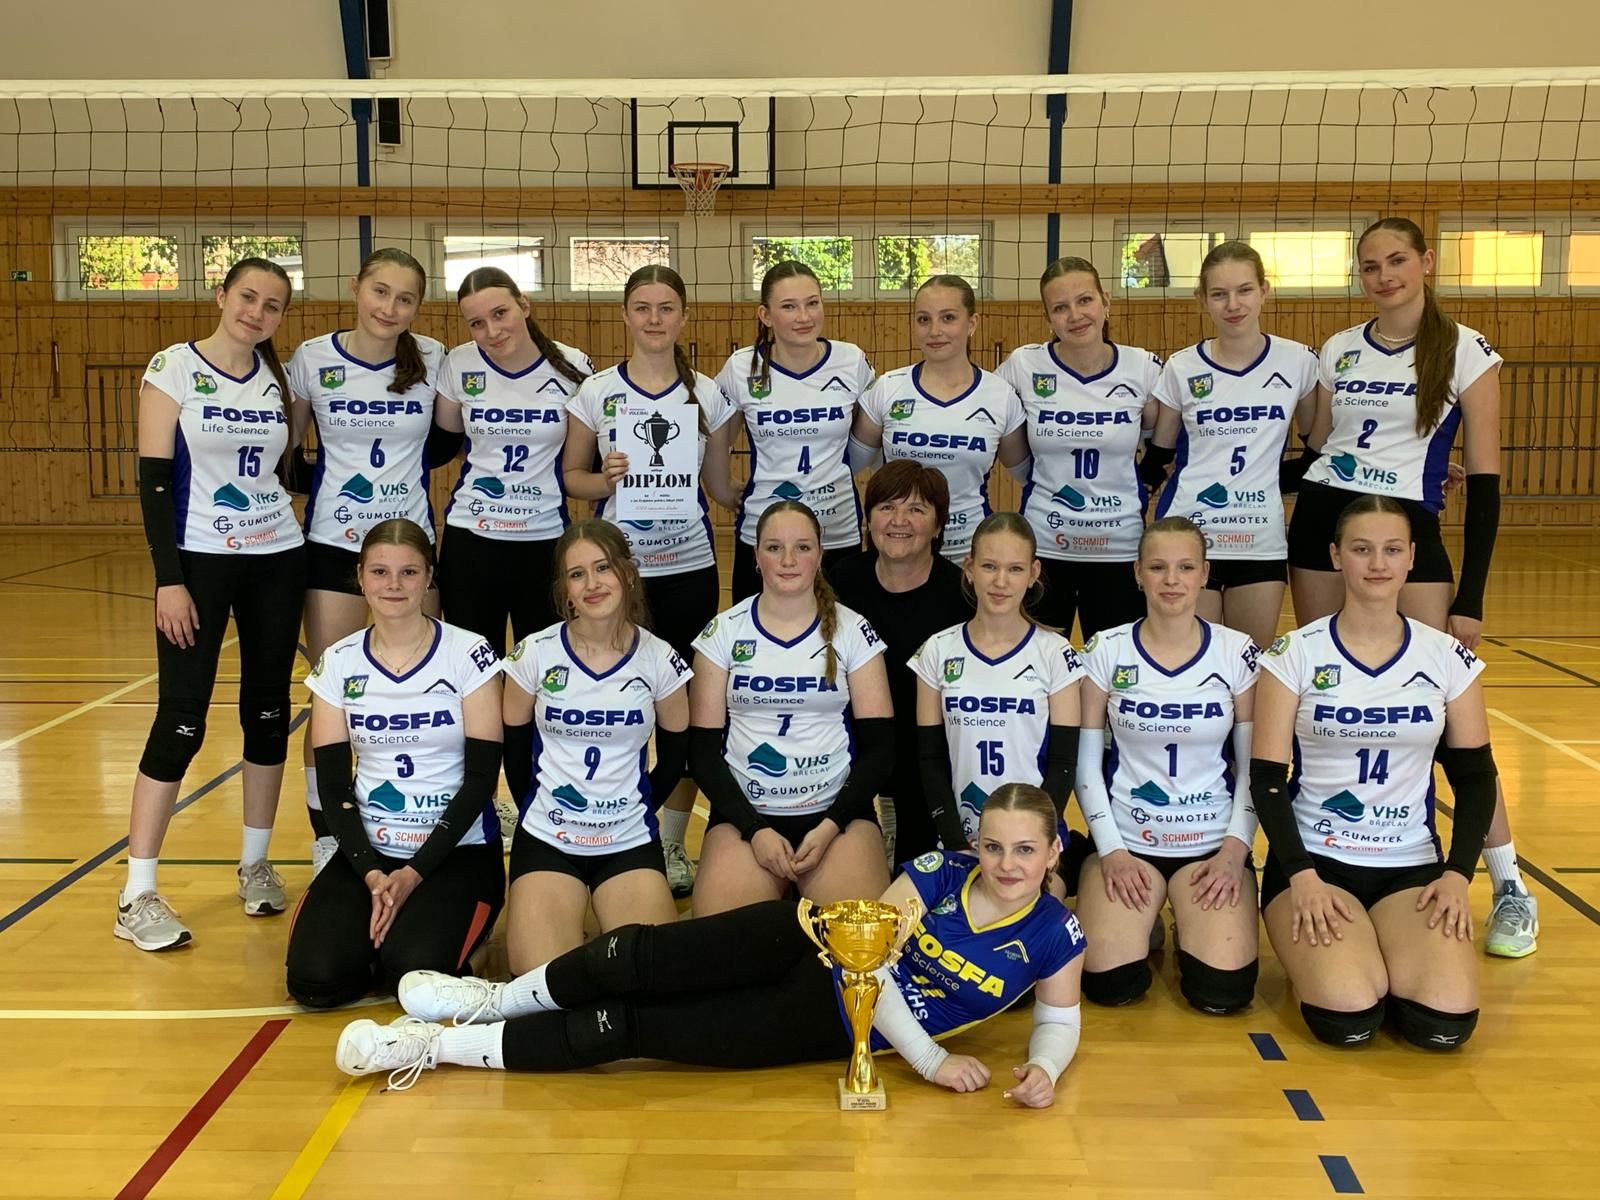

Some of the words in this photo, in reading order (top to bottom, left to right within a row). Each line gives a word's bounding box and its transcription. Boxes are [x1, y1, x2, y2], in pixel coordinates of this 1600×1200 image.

[329, 400, 423, 415] FOSFA
[1344, 397, 1389, 407] Science
[203, 405, 288, 424] FOSFA
[470, 408, 560, 424] FOSFA
[757, 406, 845, 425] FOSFA
[1038, 410, 1132, 425] FOSFA
[1197, 405, 1286, 425] FOSFA
[202, 423, 224, 434] Life
[227, 425, 270, 435] Science
[329, 417, 347, 427] Life
[350, 418, 395, 428] Science
[470, 427, 485, 435] Life
[487, 427, 531, 436] Science
[759, 429, 775, 438] Life
[777, 426, 819, 437] Science
[1036, 429, 1053, 437] Life
[1057, 429, 1103, 438] Science
[1218, 426, 1257, 436] Science
[1357, 419, 1379, 449] 2
[892, 432, 987, 452] FOSFA
[370, 438, 385, 469] 6
[502, 445, 530, 473] 12
[797, 446, 812, 475] 4
[892, 448, 907, 457] Life
[910, 451, 955, 461] Science
[1230, 445, 1247, 476] 5
[238, 446, 264, 478] 15
[1070, 448, 1100, 480] 10
[623, 474, 692, 488] DIPLOM
[1363, 467, 1397, 484] VHS
[380, 483, 409, 496] VHS
[511, 484, 542, 496] VHS
[811, 482, 836, 494] HS
[251, 491, 279, 504] VHS
[1091, 496, 1122, 507] VHS
[1235, 490, 1266, 502] VHS
[239, 511, 283, 527] GUMOTEX
[358, 511, 409, 520] GUMOTEX
[814, 508, 837, 516] OTEX
[949, 513, 967, 525] HS
[1069, 519, 1121, 528] GUMOTEX
[1212, 516, 1269, 524] GUMOTEX
[638, 536, 690, 546] GUMOTEX
[1072, 537, 1110, 546] SCHMIDT
[1216, 534, 1256, 543] SCHMIDT
[643, 552, 680, 563] SCHMIDT
[732, 675, 838, 692] FOSFA
[732, 695, 750, 704] Life
[753, 696, 804, 705] Science
[945, 696, 1036, 715] FOSFA
[1119, 698, 1224, 719] FOSFA
[1313, 704, 1433, 725] FOSFA
[350, 710, 455, 731] FOSFA
[544, 706, 644, 726] FOSFA
[964, 717, 1006, 727] Science
[545, 725, 562, 736] Life
[566, 729, 612, 738] Science
[777, 714, 793, 736] 7
[1117, 717, 1135, 730] Life
[1139, 722, 1191, 733] Science
[1313, 725, 1336, 738] Life
[1339, 728, 1396, 739] Science
[351, 734, 367, 745] Life
[369, 734, 419, 745] Science
[584, 746, 601, 780] 9
[794, 754, 830, 768] VHS
[976, 740, 1005, 776] 15
[1164, 743, 1178, 777] 1
[394, 753, 414, 778] 3
[1355, 748, 1389, 785] 14
[413, 793, 451, 808] VHS
[595, 797, 628, 809] VHS
[1178, 791, 1212, 805] VHS
[1155, 812, 1217, 823] GUMOTEX
[1372, 805, 1410, 819] VHS
[395, 832, 431, 842] SCHMI
[575, 835, 614, 845] SCHMIDT
[1161, 832, 1206, 842] SCHMIDT
[1341, 830, 1403, 843] GUMOTEX
[911, 951, 960, 991] Science
[906, 983, 928, 1020] VHS
